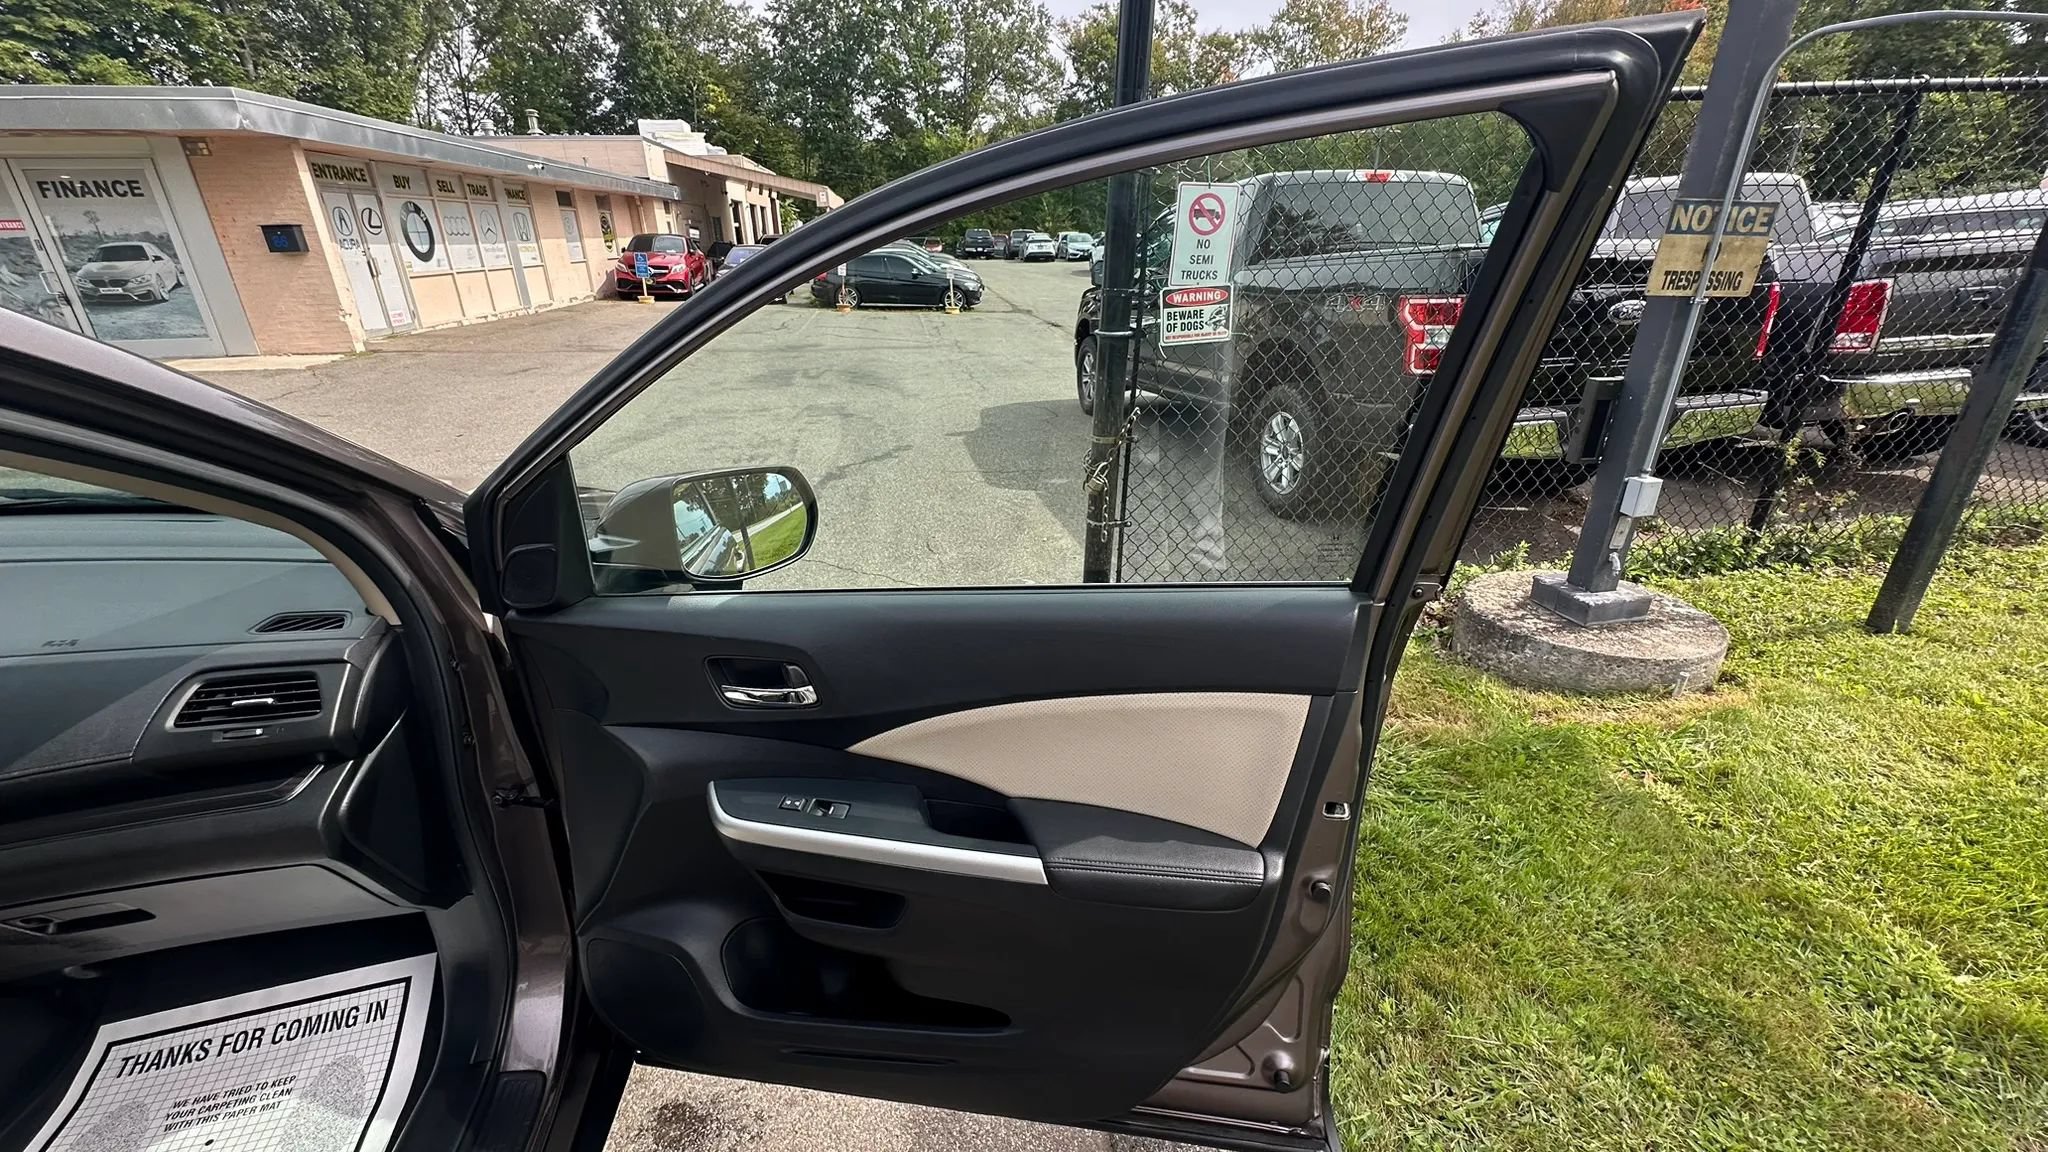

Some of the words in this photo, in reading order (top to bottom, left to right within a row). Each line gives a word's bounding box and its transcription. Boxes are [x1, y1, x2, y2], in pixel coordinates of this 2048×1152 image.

[311, 162, 367, 182] ENTRANCE
[36, 180, 144, 198] FINANCE
[392, 174, 411, 190] BUY
[436, 180, 456, 193] SELL
[466, 183, 489, 197] TRADE
[1670, 204, 1775, 233] NOICE
[1196, 239, 1211, 249] NO
[1189, 254, 1214, 265] SEMI
[1181, 270, 1218, 280] TRUCKS
[1661, 270, 1744, 291] TRESPSSING
[1172, 291, 1221, 303] WARNING
[1166, 309, 1205, 321] BEWARE
[1166, 322, 1178, 333] OF
[1180, 320, 1204, 332] DOGS
[116, 1038, 212, 1079] THANKS
[217, 1027, 266, 1057] FOR
[271, 1005, 360, 1045] COMING
[365, 999, 389, 1024] IN
[172, 1098, 191, 1110] WE
[192, 1091, 221, 1106] HAVE
[222, 1084, 253, 1099] TRIED
[255, 1081, 269, 1092] TO
[270, 1075, 297, 1089] KEEP
[165, 1107, 198, 1121] YOUR
[198, 1095, 257, 1115] CARPETING
[259, 1088, 293, 1101] CLEAN
[163, 1120, 194, 1132] WITH
[195, 1113, 221, 1126] THIS
[222, 1105, 258, 1120] PAPER
[259, 1101, 282, 1113] MAT
